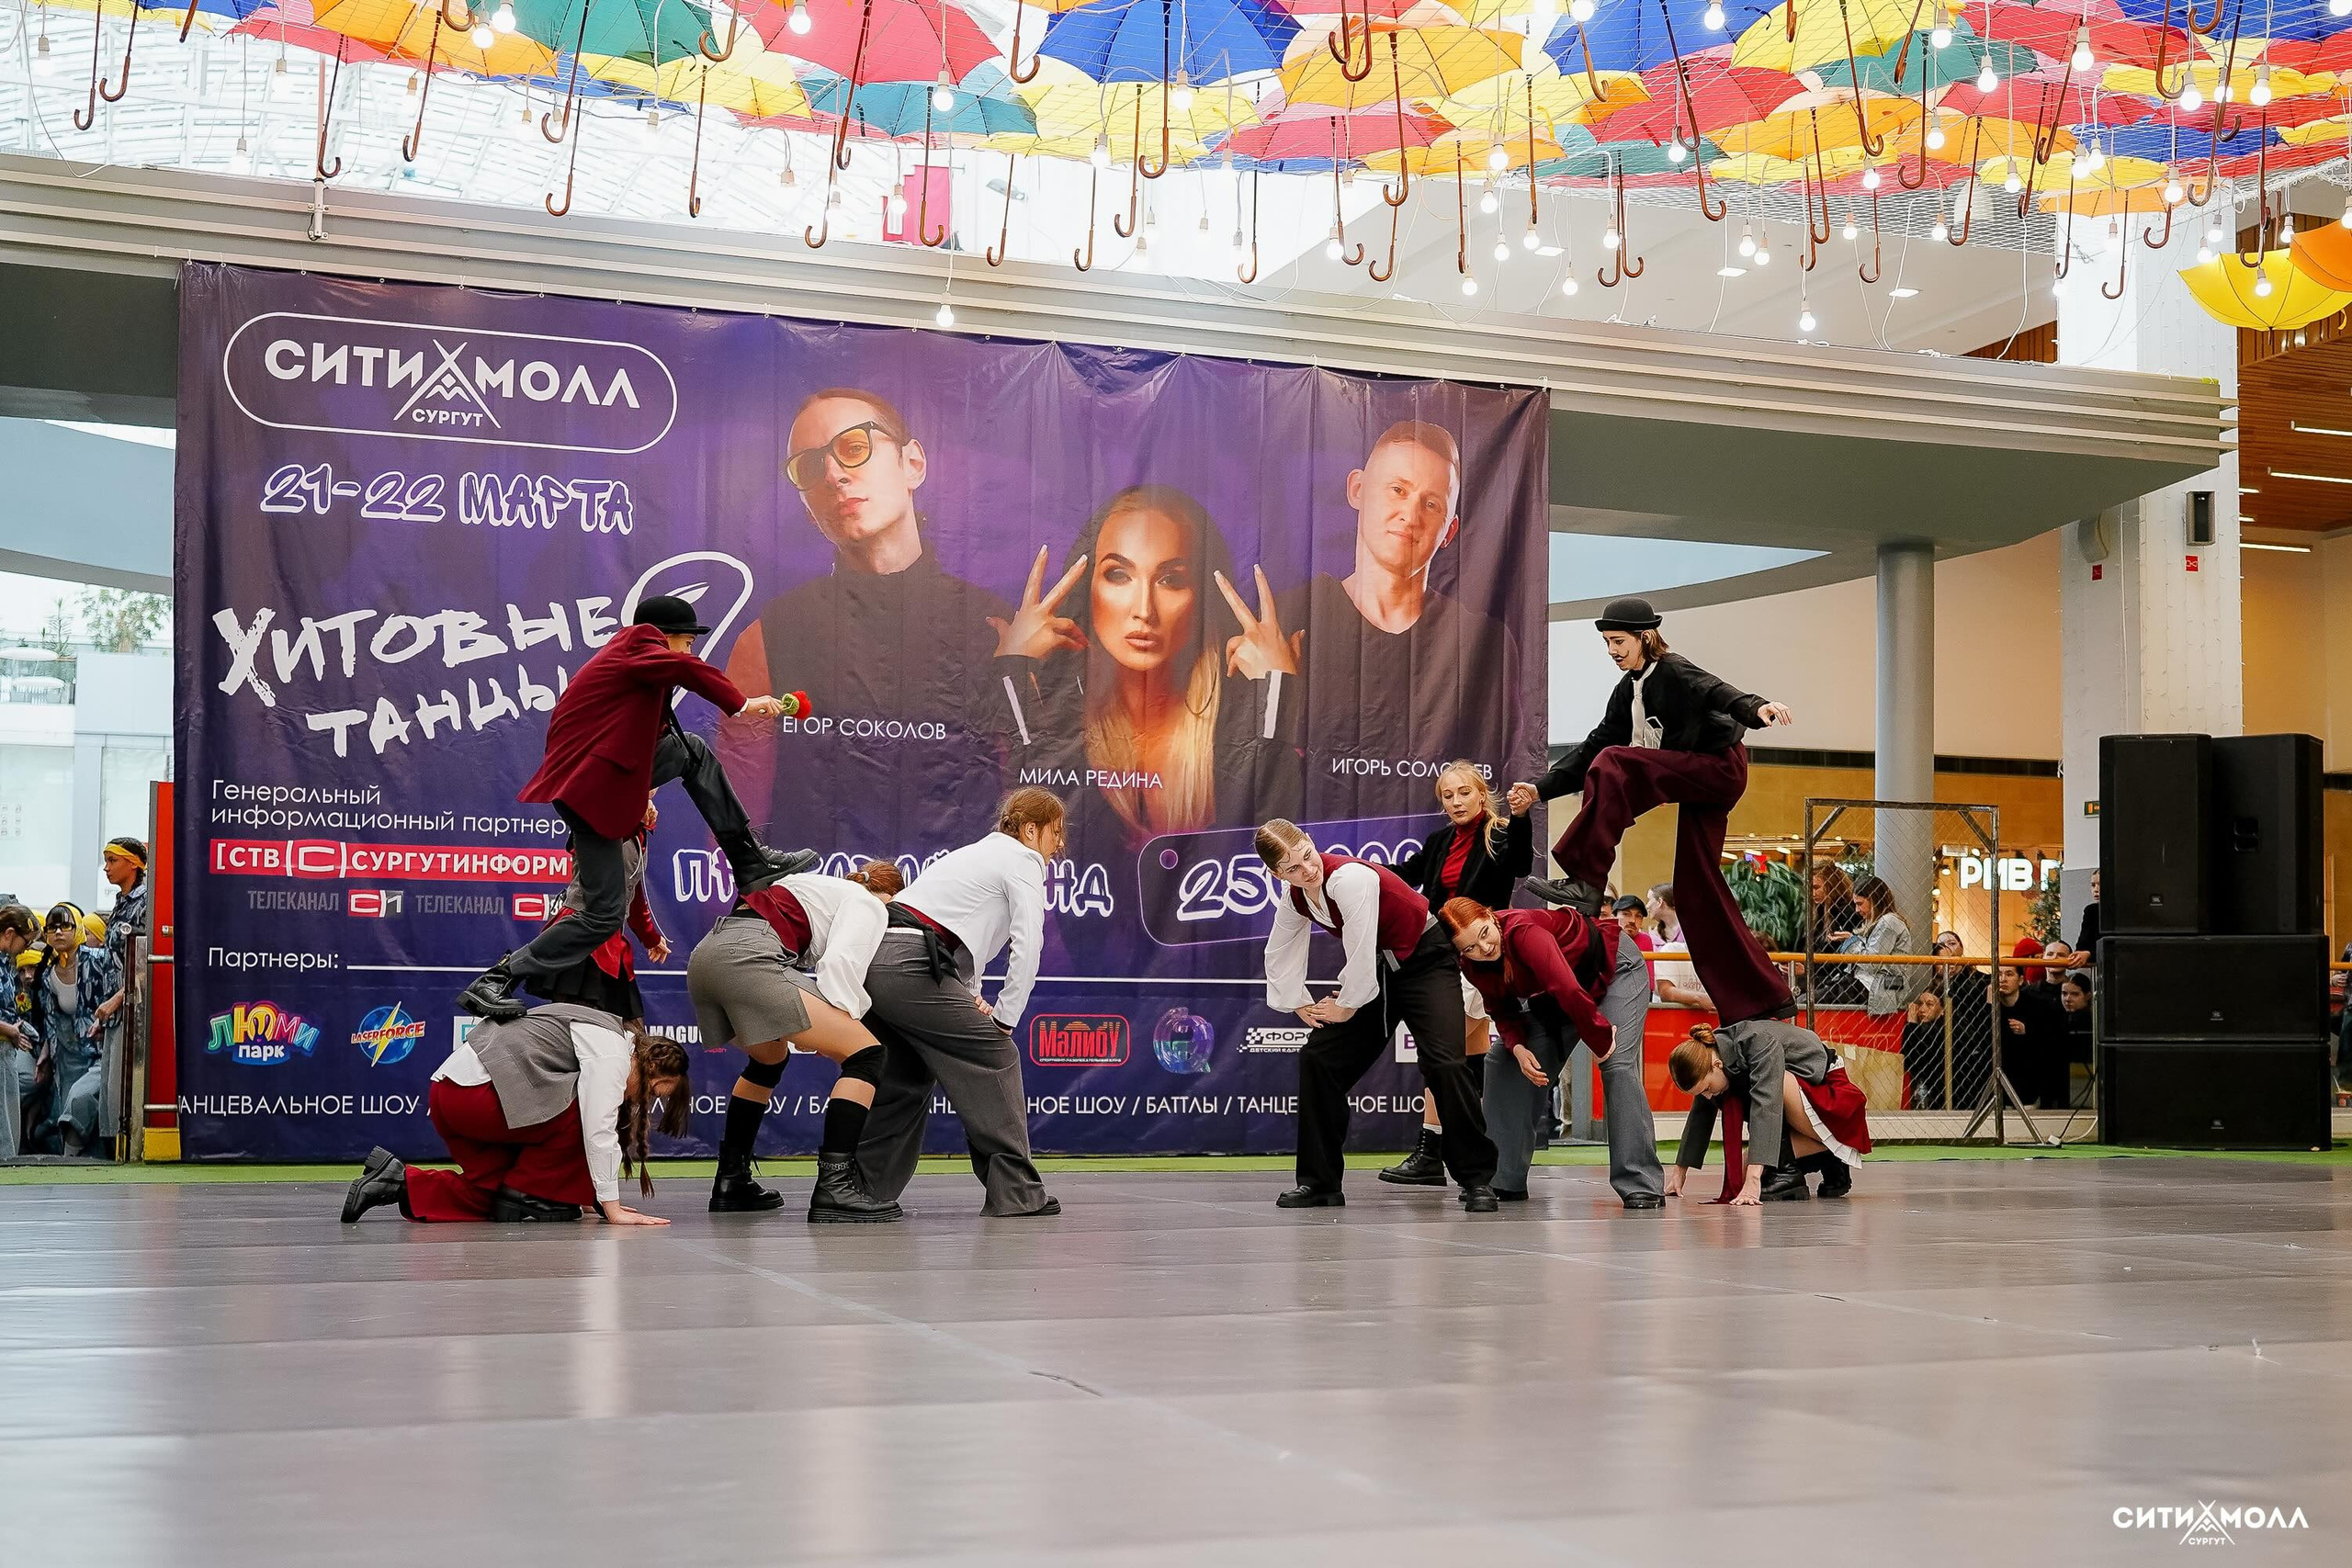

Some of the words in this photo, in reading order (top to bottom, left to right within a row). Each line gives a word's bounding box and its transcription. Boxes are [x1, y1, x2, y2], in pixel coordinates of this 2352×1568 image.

[264, 339, 426, 389] СИТИ
[474, 354, 640, 410] МОЛЛ
[411, 408, 483, 428] СУРГУТ
[259, 462, 447, 523] 21-22
[458, 471, 634, 535] МАРТА
[839, 717, 947, 741] СОКОЛОВ
[1019, 768, 1080, 787] МИЛА
[1086, 770, 1164, 790] РЕДИНА
[1332, 758, 1392, 777] ИГОРЬ
[1396, 760, 1493, 781] СОЛОЕВ
[211, 779, 381, 807] Генеральный
[211, 805, 455, 831] информационный
[462, 815, 571, 840] партнер
[351, 850, 573, 877] СУРГУТИНФОРМ
[1042, 858, 1114, 918] НД
[1177, 853, 1283, 921] 25
[247, 889, 340, 912] ТЕЛЕКАНАЛ
[415, 894, 505, 916] ТЕЛЕКАНАЛ
[209, 946, 339, 973] Партнеры:
[350, 1021, 426, 1044] LASERFORCE
[360, 1095, 420, 1116] ШОУ
[1075, 1096, 1126, 1114] ШОУ
[1146, 1096, 1217, 1114] БАТТЛЫ
[1393, 1095, 1426, 1113] ШО
